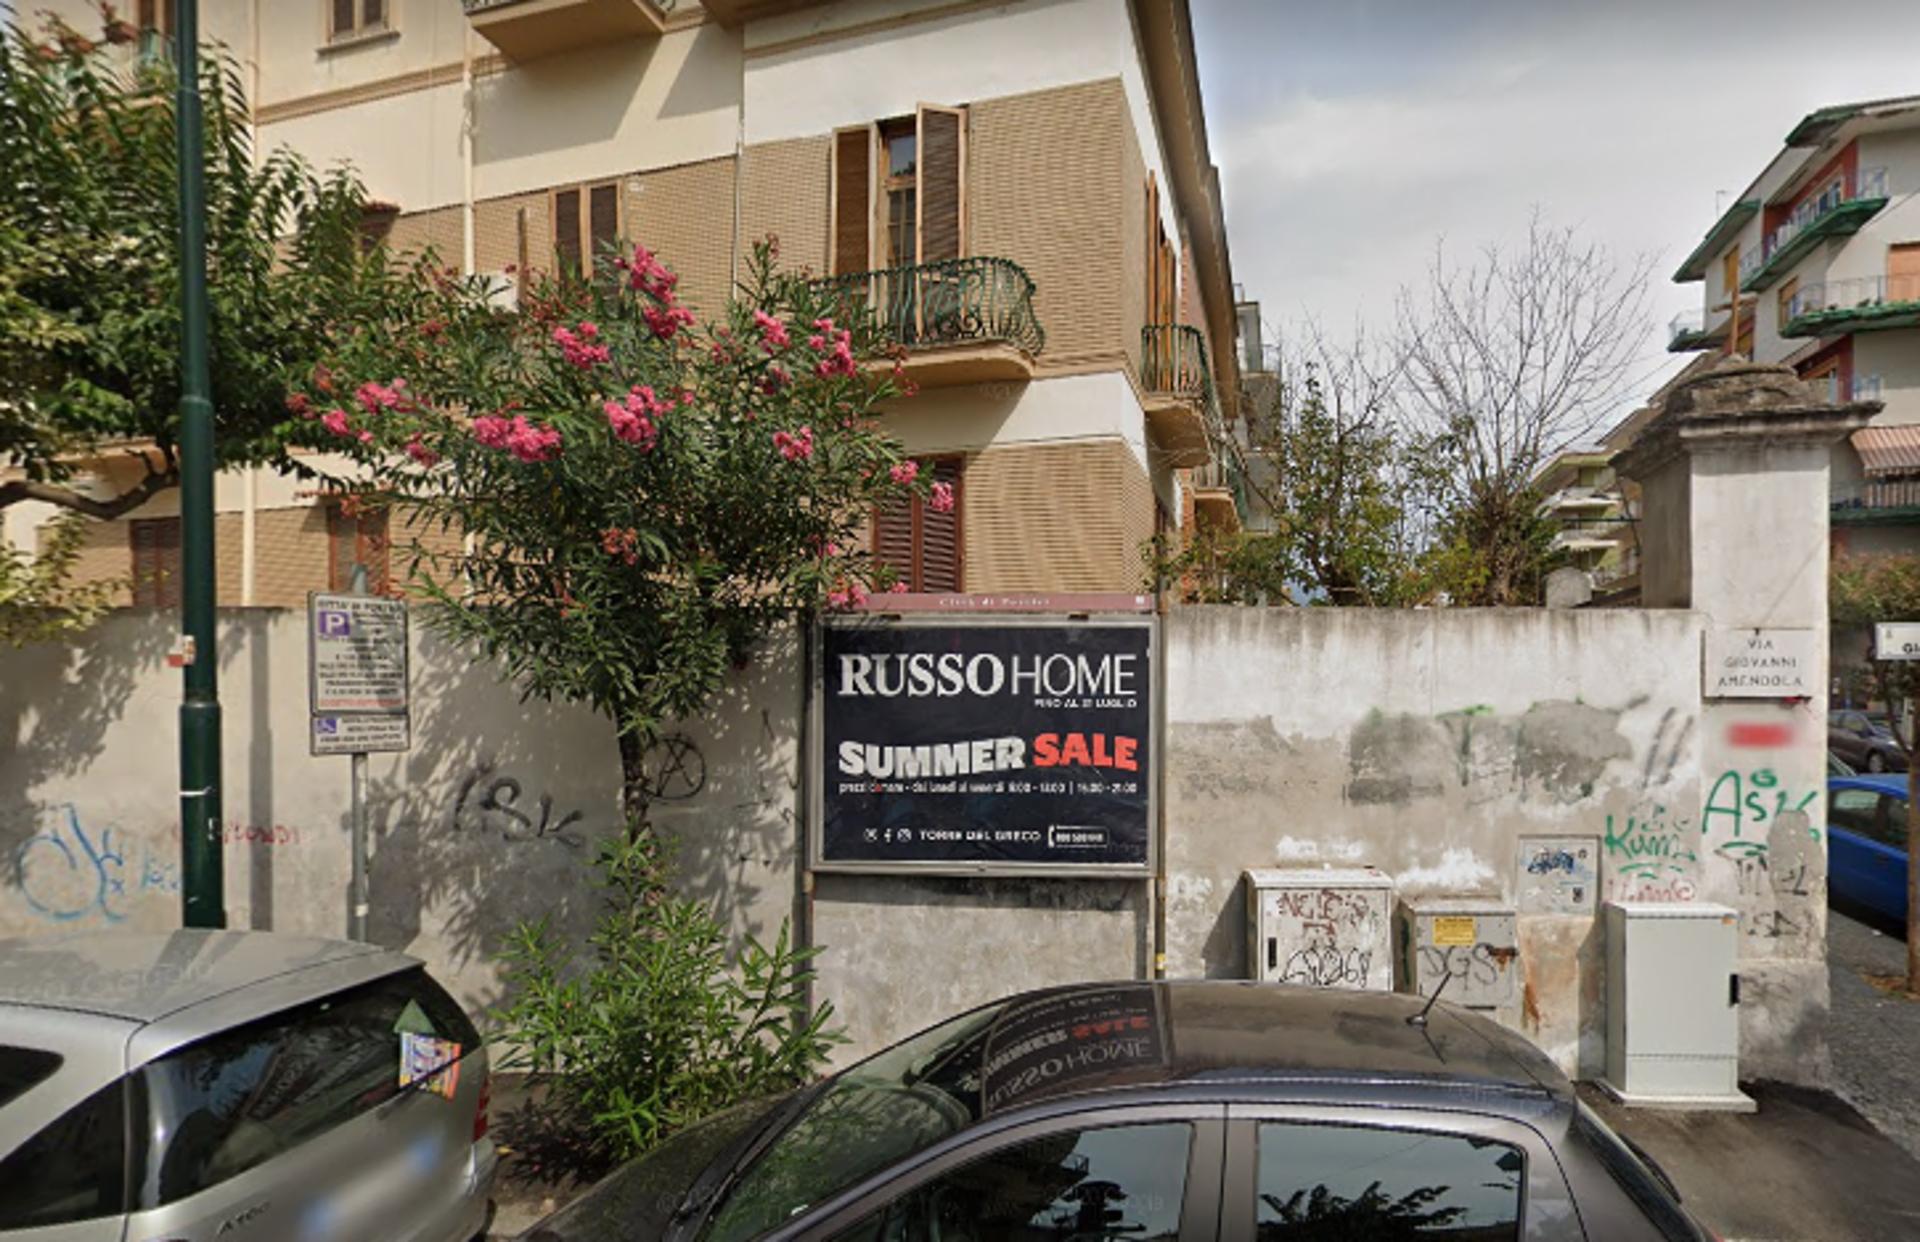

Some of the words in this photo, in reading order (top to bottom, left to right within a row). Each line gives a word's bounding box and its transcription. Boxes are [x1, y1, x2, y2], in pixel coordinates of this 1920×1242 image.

[1748, 640, 1775, 650] VIA
[1724, 656, 1797, 668] GIOVANNI
[838, 653, 1005, 697] RUSSO
[1011, 653, 1137, 696] HOME
[1718, 675, 1803, 687] AMENDOLA
[838, 736, 1026, 779] SUMMER
[1033, 732, 1138, 772] SALE
